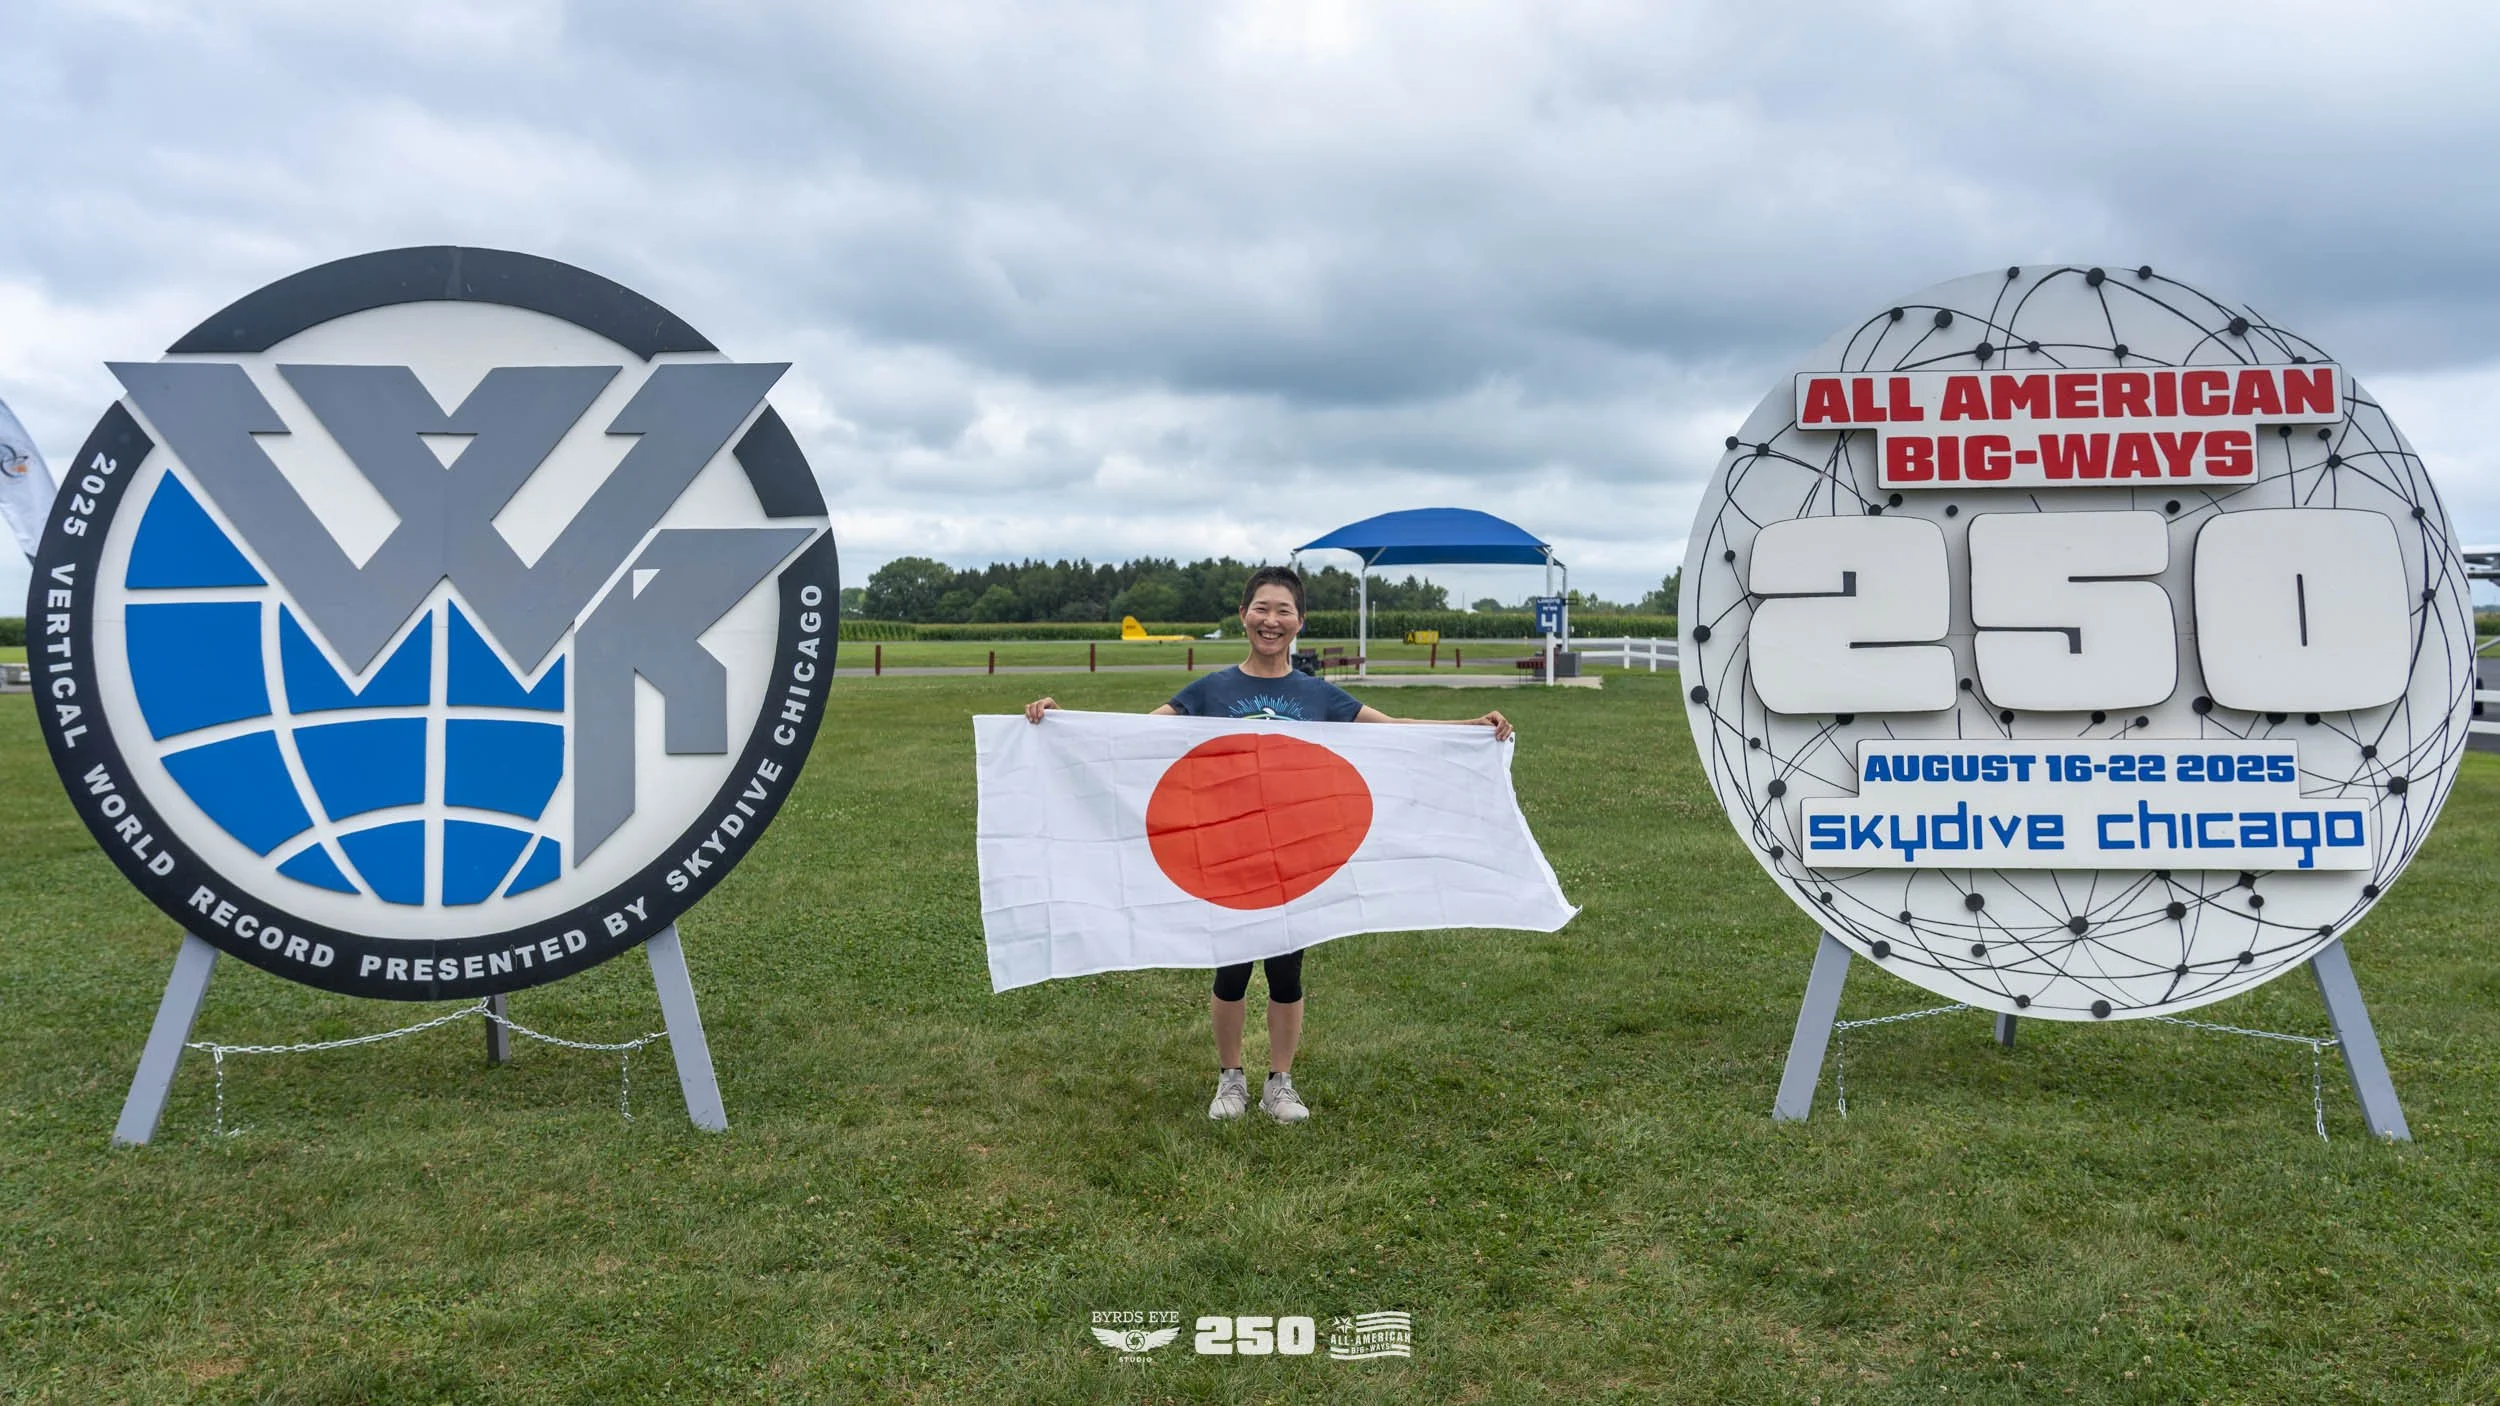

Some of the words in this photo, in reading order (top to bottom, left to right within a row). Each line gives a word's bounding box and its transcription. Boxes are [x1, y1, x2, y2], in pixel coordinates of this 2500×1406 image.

[1803, 377, 1924, 424] ALL
[1941, 368, 2334, 421] AMERICAN
[63, 452, 117, 537] 2025
[1887, 430, 2253, 482] BIG-WAYS
[1541, 613, 1557, 632] 4
[1748, 507, 2412, 716] 250
[47, 563, 88, 748] VERTICAL
[774, 584, 823, 746] CHICAGO
[1864, 755, 2036, 782] AUGUST
[2046, 754, 2166, 782] 16-22
[2177, 754, 2295, 782] 2025
[83, 764, 175, 877] WORLD
[666, 758, 783, 893] SKYDIVE
[188, 885, 335, 968] RECORD
[360, 929, 588, 982] PRESENTED
[603, 897, 649, 938] BY
